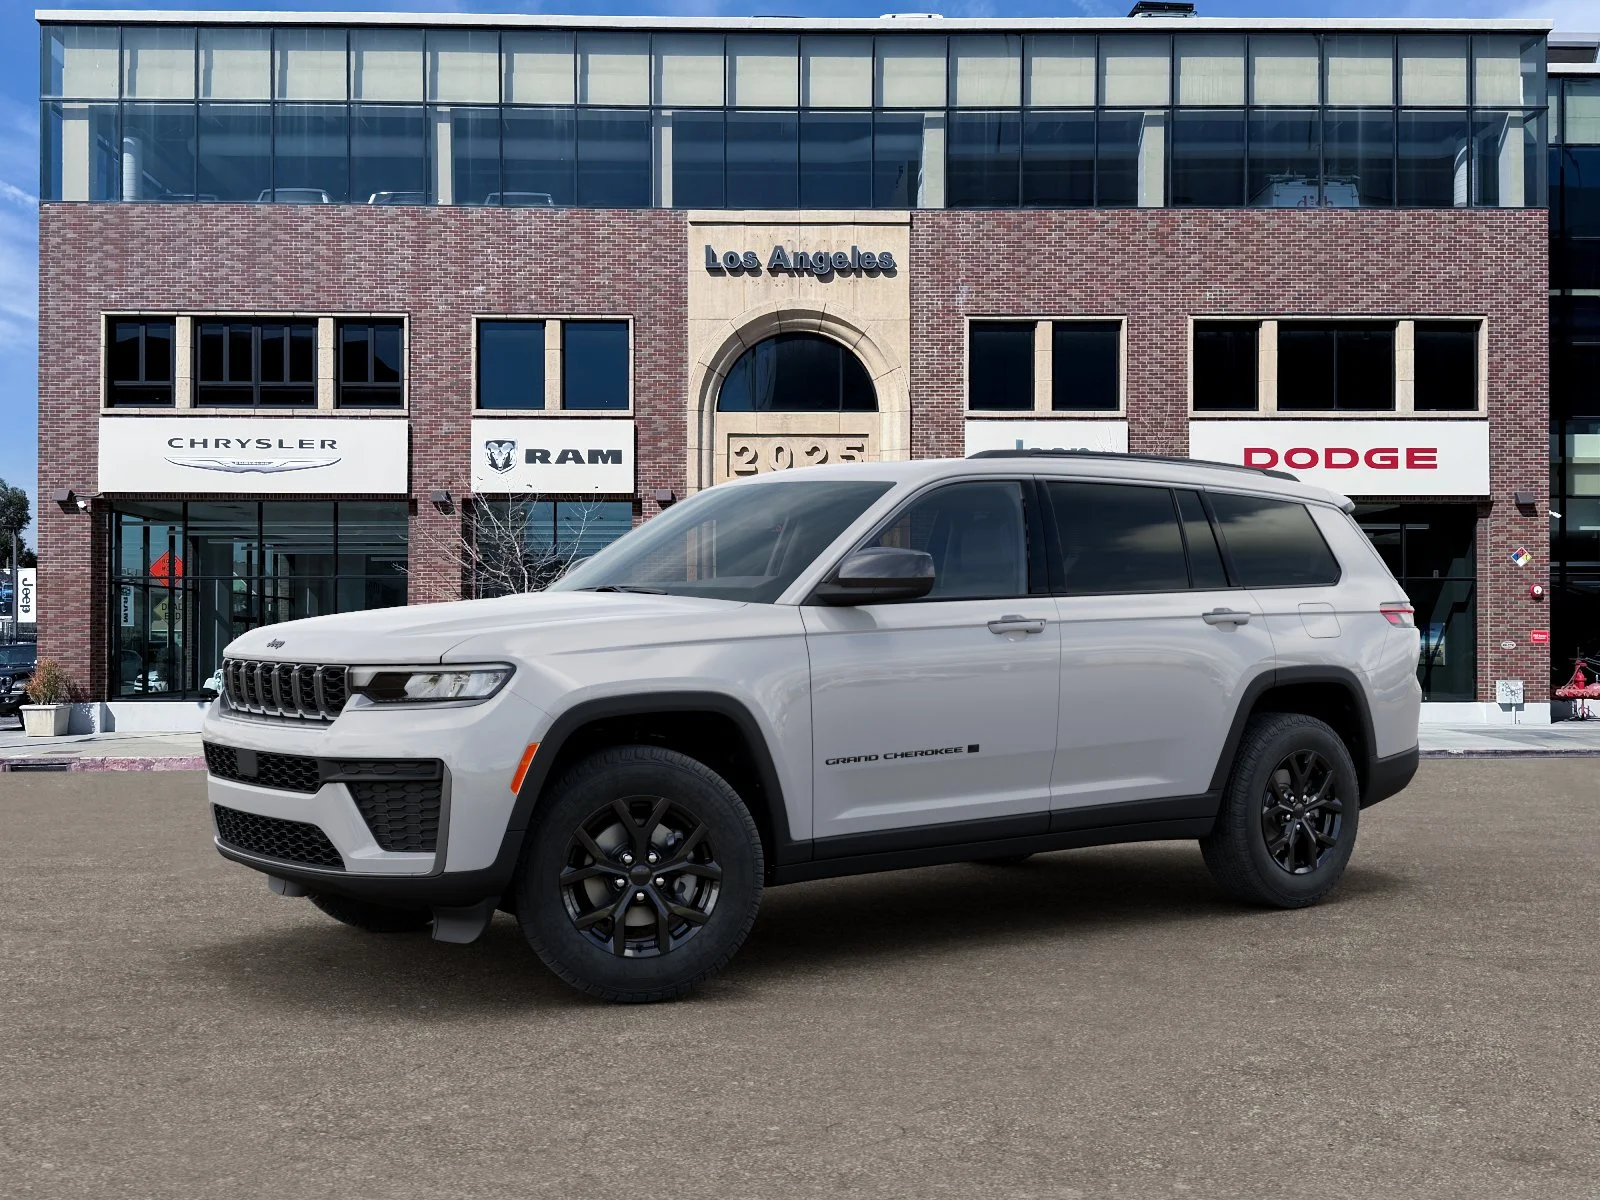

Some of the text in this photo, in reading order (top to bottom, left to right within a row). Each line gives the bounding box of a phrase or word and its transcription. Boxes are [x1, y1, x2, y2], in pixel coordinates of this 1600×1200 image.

[704, 244, 895, 276] Los Angeles
[167, 437, 338, 450] CHRYSLER
[525, 448, 623, 465] RAM
[733, 440, 866, 476] 2025
[1243, 447, 1438, 470] DODGE
[20, 577, 34, 613] Jeep
[266, 638, 286, 650] Jeep
[825, 746, 964, 766] GRAND CHEROKEE
